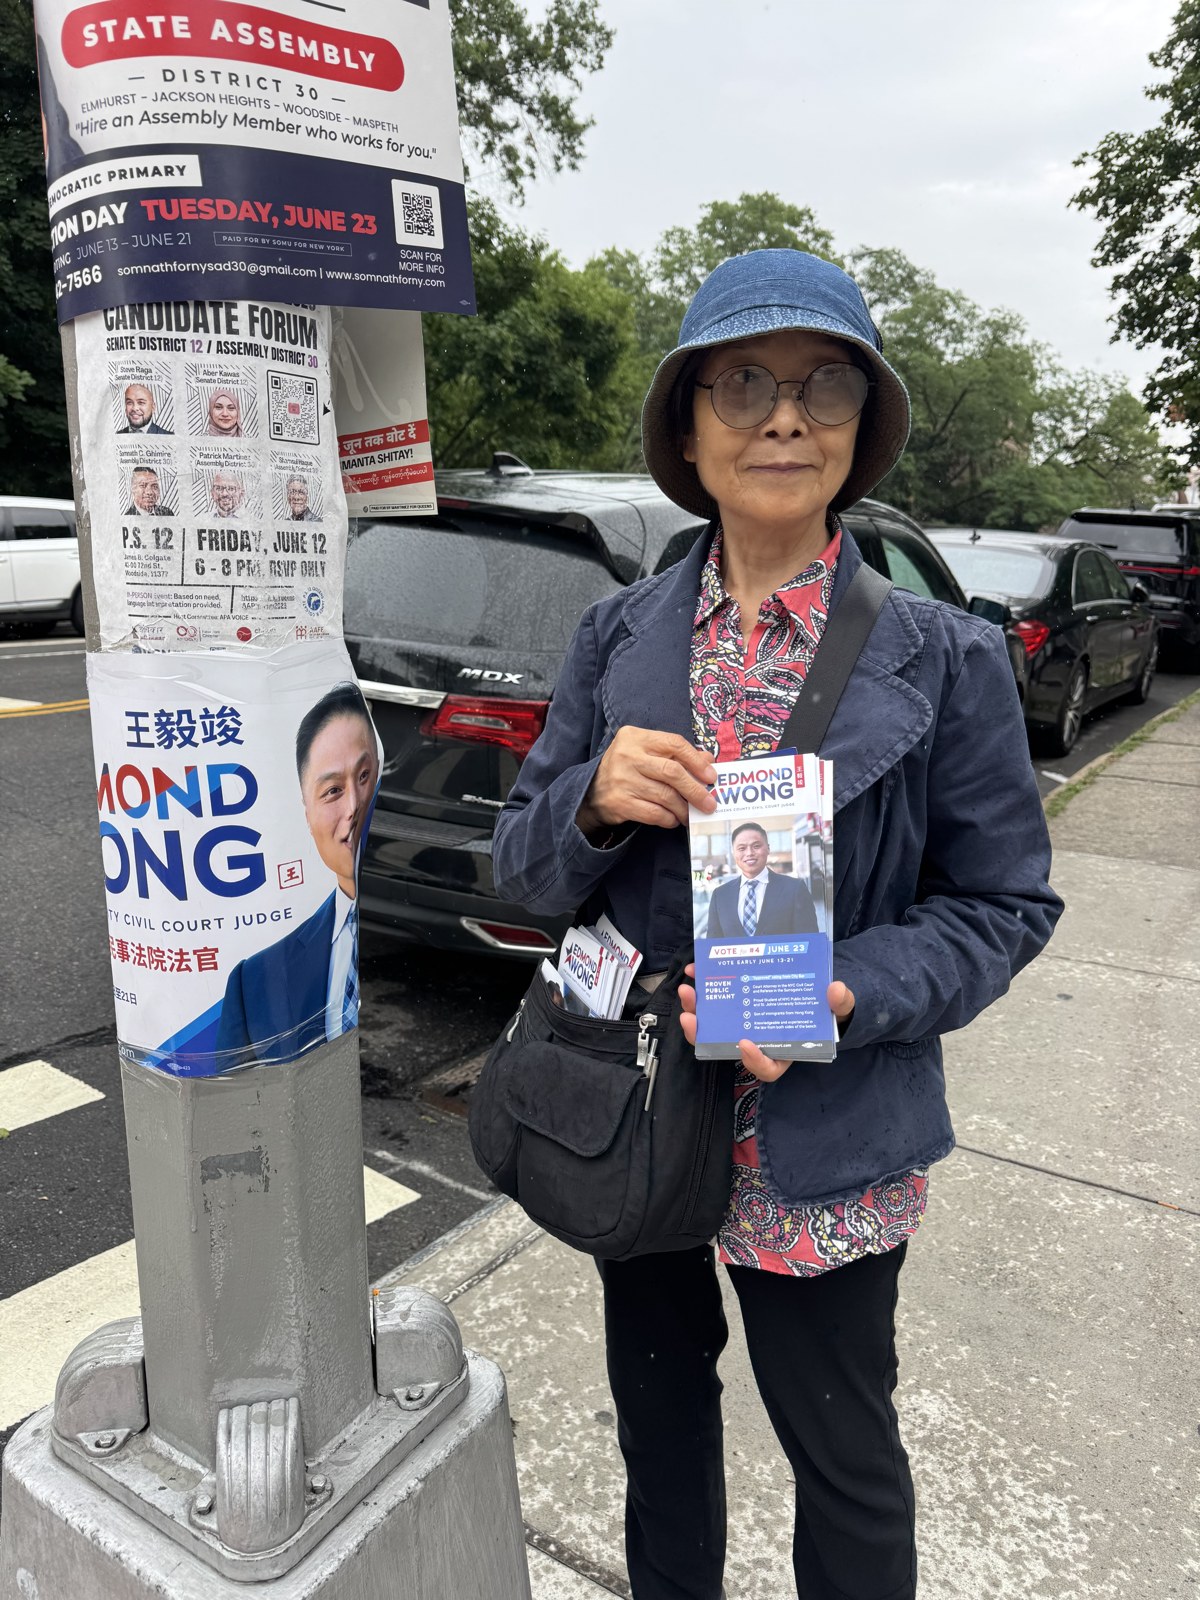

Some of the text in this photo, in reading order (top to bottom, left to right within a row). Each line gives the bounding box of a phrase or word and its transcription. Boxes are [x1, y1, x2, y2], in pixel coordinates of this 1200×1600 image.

[82, 15, 375, 72] STATE ASSEMBLY
[162, 69, 318, 100] DISTRICT 30
[81, 91, 398, 133] ELMHURST JACKSON HEIGHTS WOODSIDE MASPETH
[75, 109, 437, 160] "Hire an Assembly Member who works for you."
[107, 165, 186, 182] PRIMARY
[81, 202, 128, 232] DAY
[140, 198, 279, 228] TUESDAY,
[283, 205, 347, 232] JUNE
[350, 213, 378, 235] 23
[76, 232, 192, 260] JUNE 13 JUNE 21
[222, 235, 241, 243] PAID
[272, 239, 292, 247] SOMU
[294, 241, 307, 249] FOR
[398, 262, 445, 275] MORE INFO
[400, 249, 442, 263] SCAN FOR
[117, 261, 317, 278] somnathfornysad30@gmail.com
[325, 270, 446, 288] www.somnathforny.com
[103, 300, 318, 350] CANDIDATE FORUM
[106, 336, 135, 352] SENATE
[138, 336, 187, 352] DISTRICT
[190, 339, 204, 353] 12
[216, 341, 268, 359] ASSEMBLY
[271, 346, 305, 366] DISTRICT
[307, 355, 319, 368] 30
[136, 366, 153, 375] Raga
[364, 433, 384, 447] तक
[386, 427, 406, 443] वोट
[377, 448, 414, 464] SHITAY!
[151, 527, 174, 550] 12
[273, 531, 308, 553] JUNE
[311, 533, 327, 554] 12
[144, 554, 171, 562] Colgate
[195, 558, 206, 576] 6
[221, 558, 232, 576] 8
[173, 592, 194, 600] Based
[457, 667, 524, 685] MDX
[125, 705, 245, 749] 王毅竣
[717, 767, 793, 786] EDMOND
[719, 781, 794, 805] WONG
[99, 820, 267, 902] ONG
[283, 867, 300, 883] 王
[108, 907, 293, 933] TY CIVIL COURT JUDGE
[572, 943, 598, 974] EDMOND
[714, 947, 737, 955] VOTE
[768, 945, 790, 954] JUNE
[793, 944, 805, 952] 23
[569, 956, 595, 990] WONG
